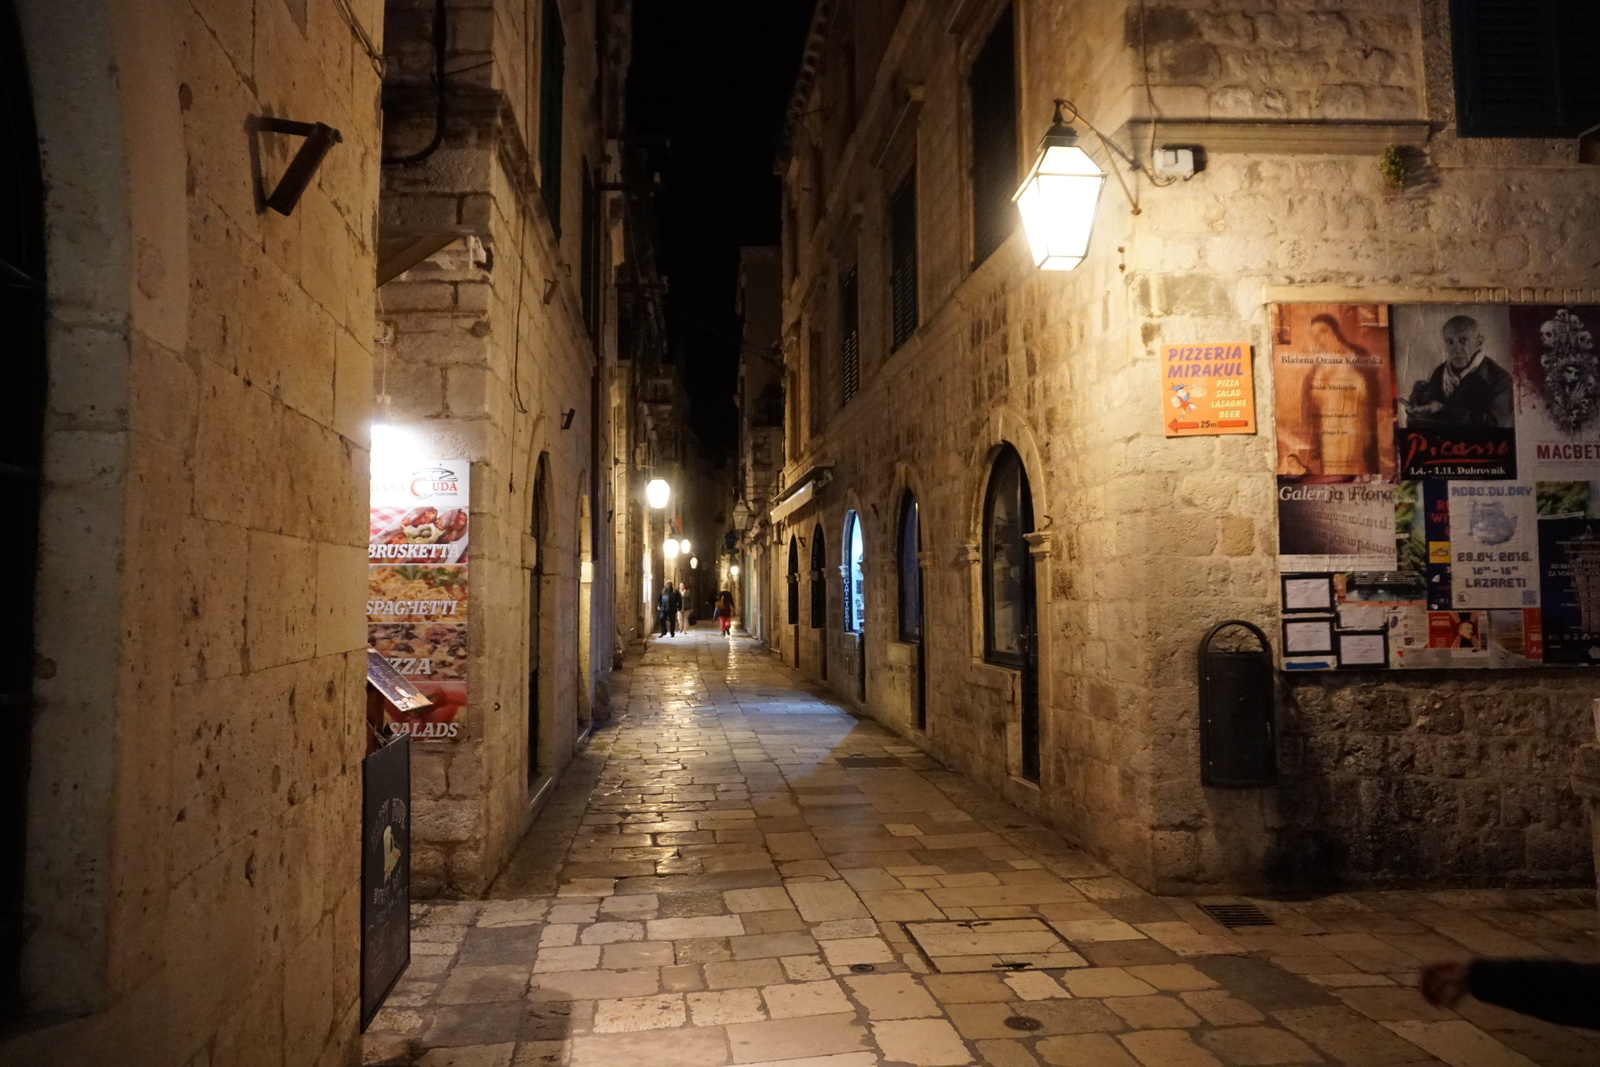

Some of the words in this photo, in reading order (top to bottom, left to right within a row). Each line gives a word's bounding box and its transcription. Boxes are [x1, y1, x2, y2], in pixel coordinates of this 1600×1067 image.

[1168, 346, 1242, 361] PIZZERIA
[1316, 356, 1343, 364] Ozana
[1345, 356, 1384, 364] Kotorska
[1167, 363, 1243, 378] MIRAKUL
[1216, 379, 1240, 387] PIZZA
[1216, 389, 1242, 398] SALAD
[1211, 399, 1247, 408] LASAGNE
[1219, 410, 1241, 419] BEER
[1403, 432, 1509, 470] Picasso
[1457, 466, 1506, 475] Dubrovnik
[1280, 485, 1344, 503] Galerija
[1351, 485, 1393, 500] Flora
[369, 543, 459, 558] BRUSKETTA
[1465, 577, 1527, 588] LAZARETI
[366, 600, 458, 615] SPAGHETTI
[384, 657, 431, 675] ZZA
[390, 722, 458, 738] SALADS
